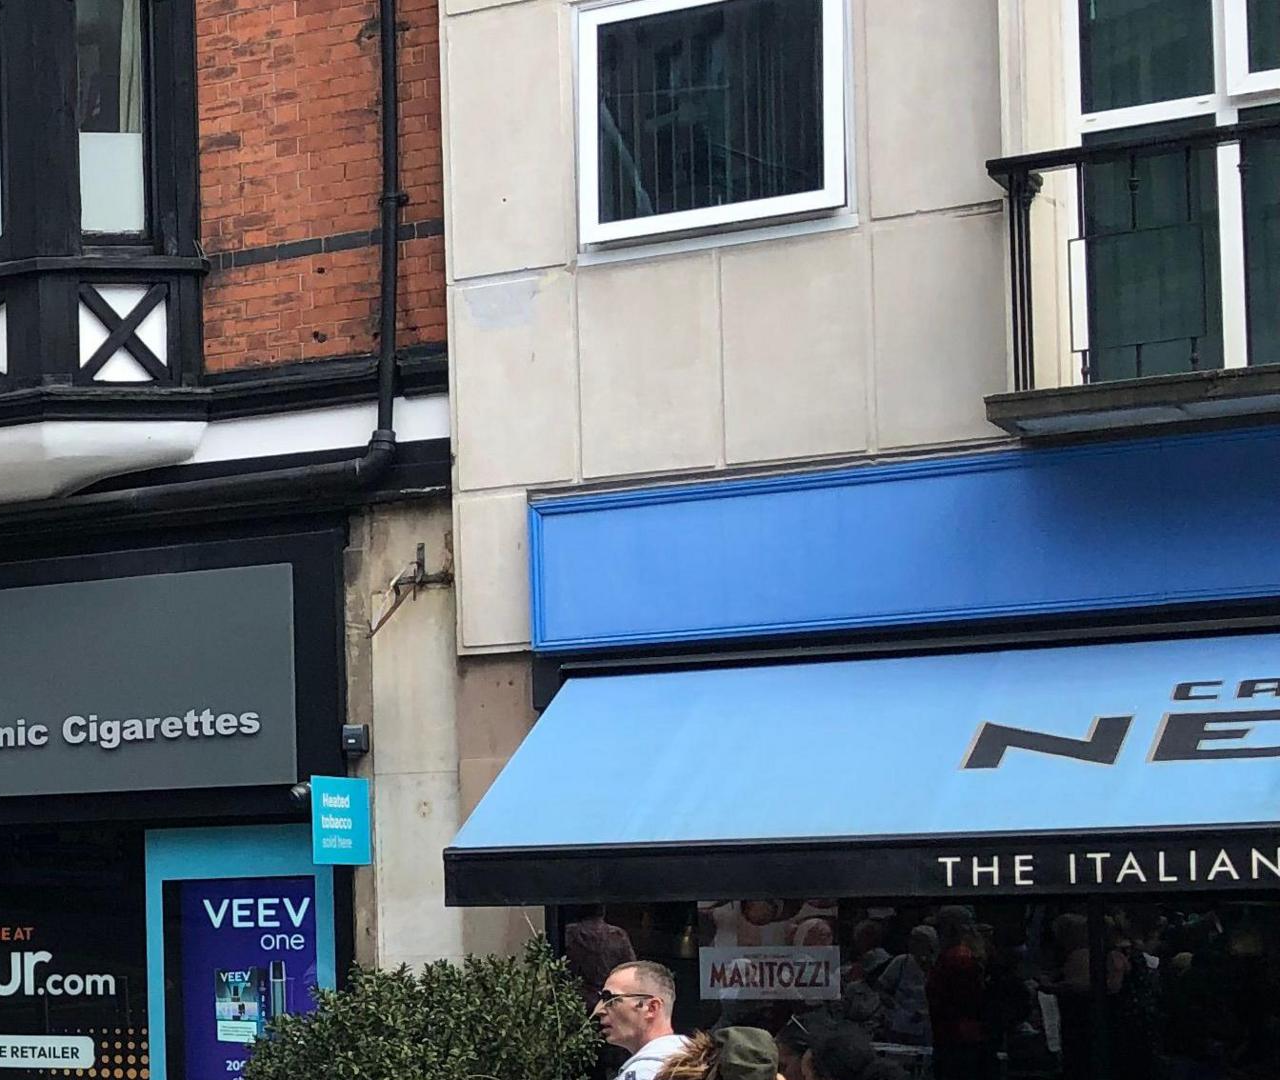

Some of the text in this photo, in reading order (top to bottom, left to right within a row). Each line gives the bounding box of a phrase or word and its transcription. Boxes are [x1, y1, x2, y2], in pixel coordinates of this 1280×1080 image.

[61, 708, 261, 750] Cigarettes
[322, 792, 351, 809] Heated
[321, 813, 353, 830] tobacco
[938, 848, 1280, 887] THE ITALIAN
[203, 896, 311, 929] VEEV
[14, 927, 34, 942] AT
[260, 933, 305, 951] one
[220, 971, 251, 982] VEEV
[709, 960, 831, 989] MARITOZZI
[11, 1046, 80, 1060] RETAILER
